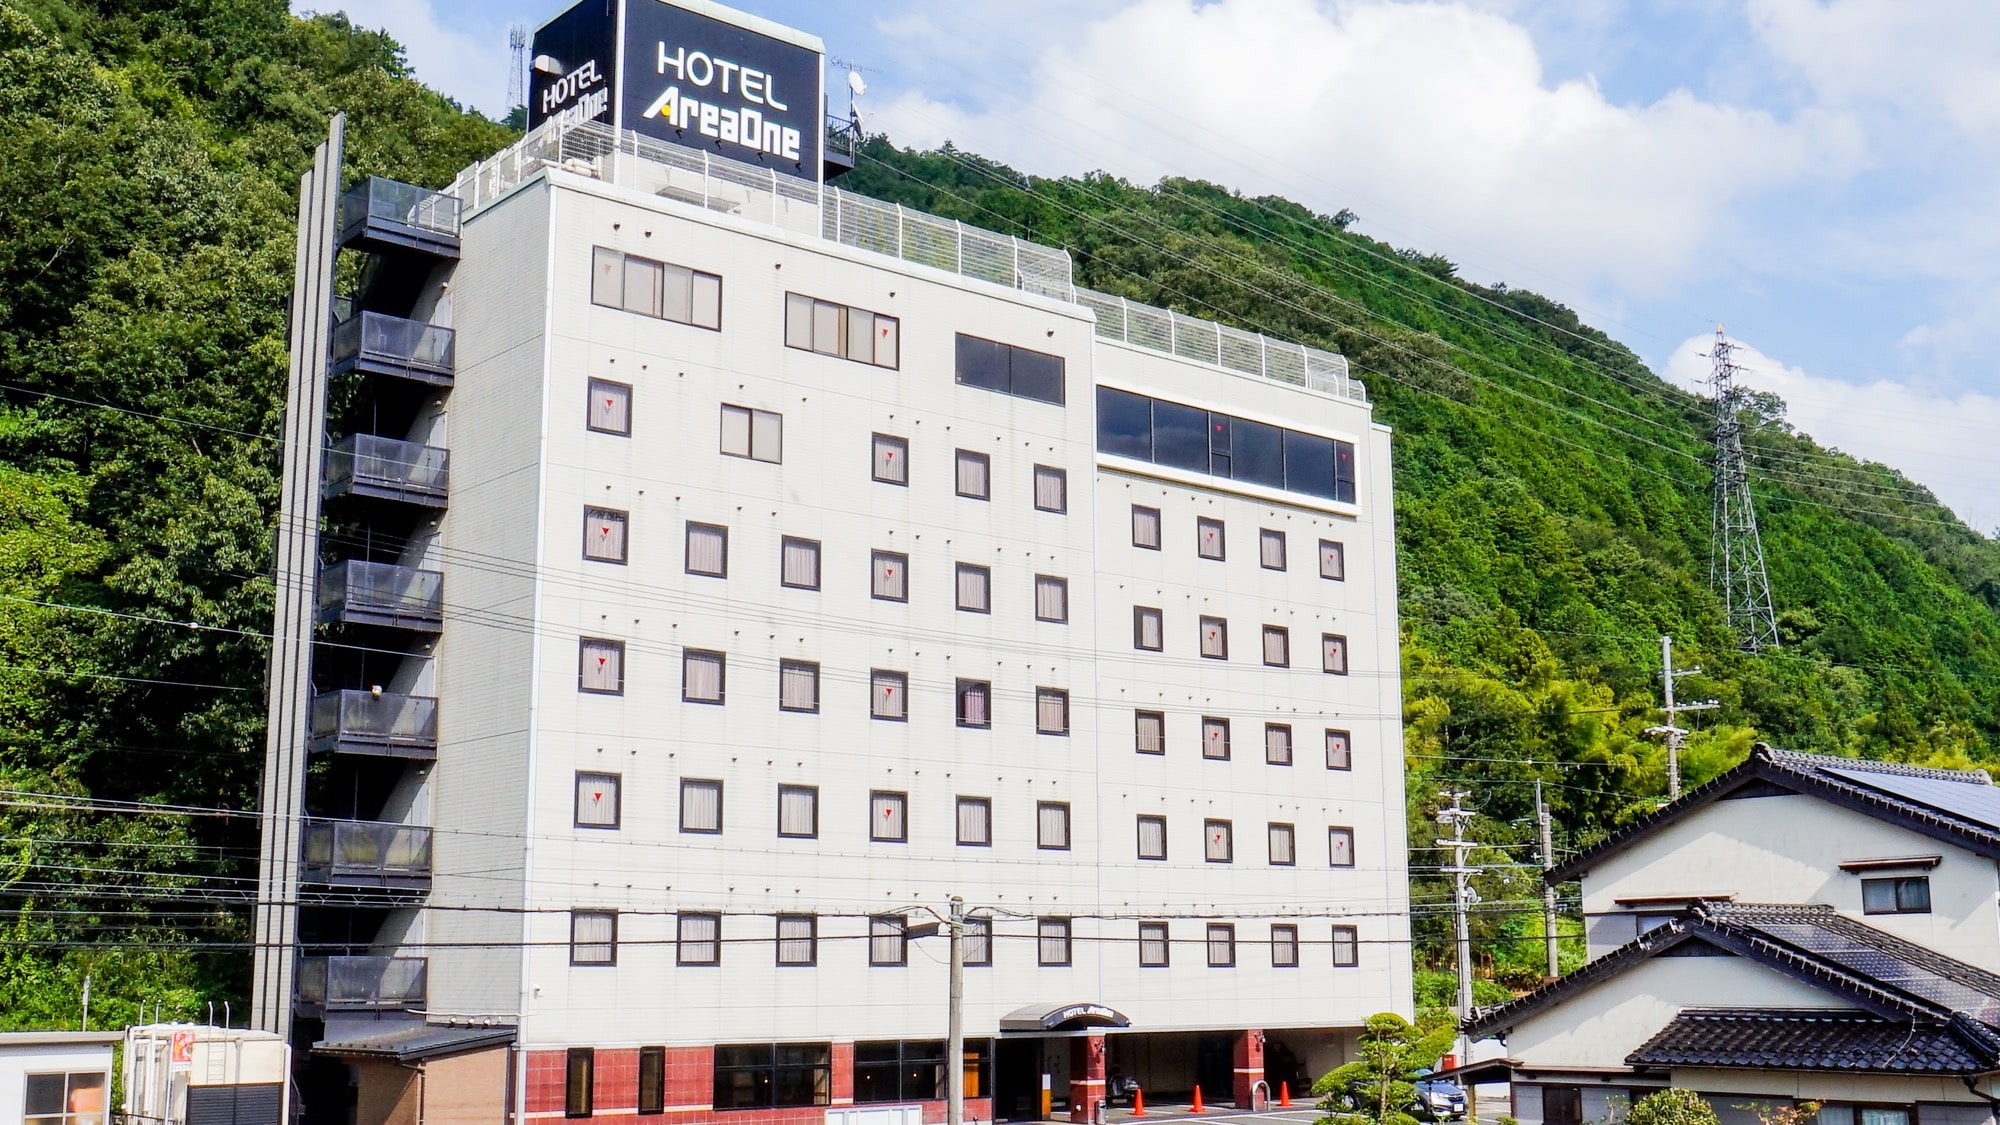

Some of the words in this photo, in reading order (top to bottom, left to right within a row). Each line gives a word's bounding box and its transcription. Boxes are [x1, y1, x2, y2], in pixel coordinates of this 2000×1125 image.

[543, 59, 602, 113] HOTEL
[657, 41, 787, 112] HOTEL
[643, 86, 800, 161] AreaOne
[1063, 1007, 1086, 1019] HOTEL
